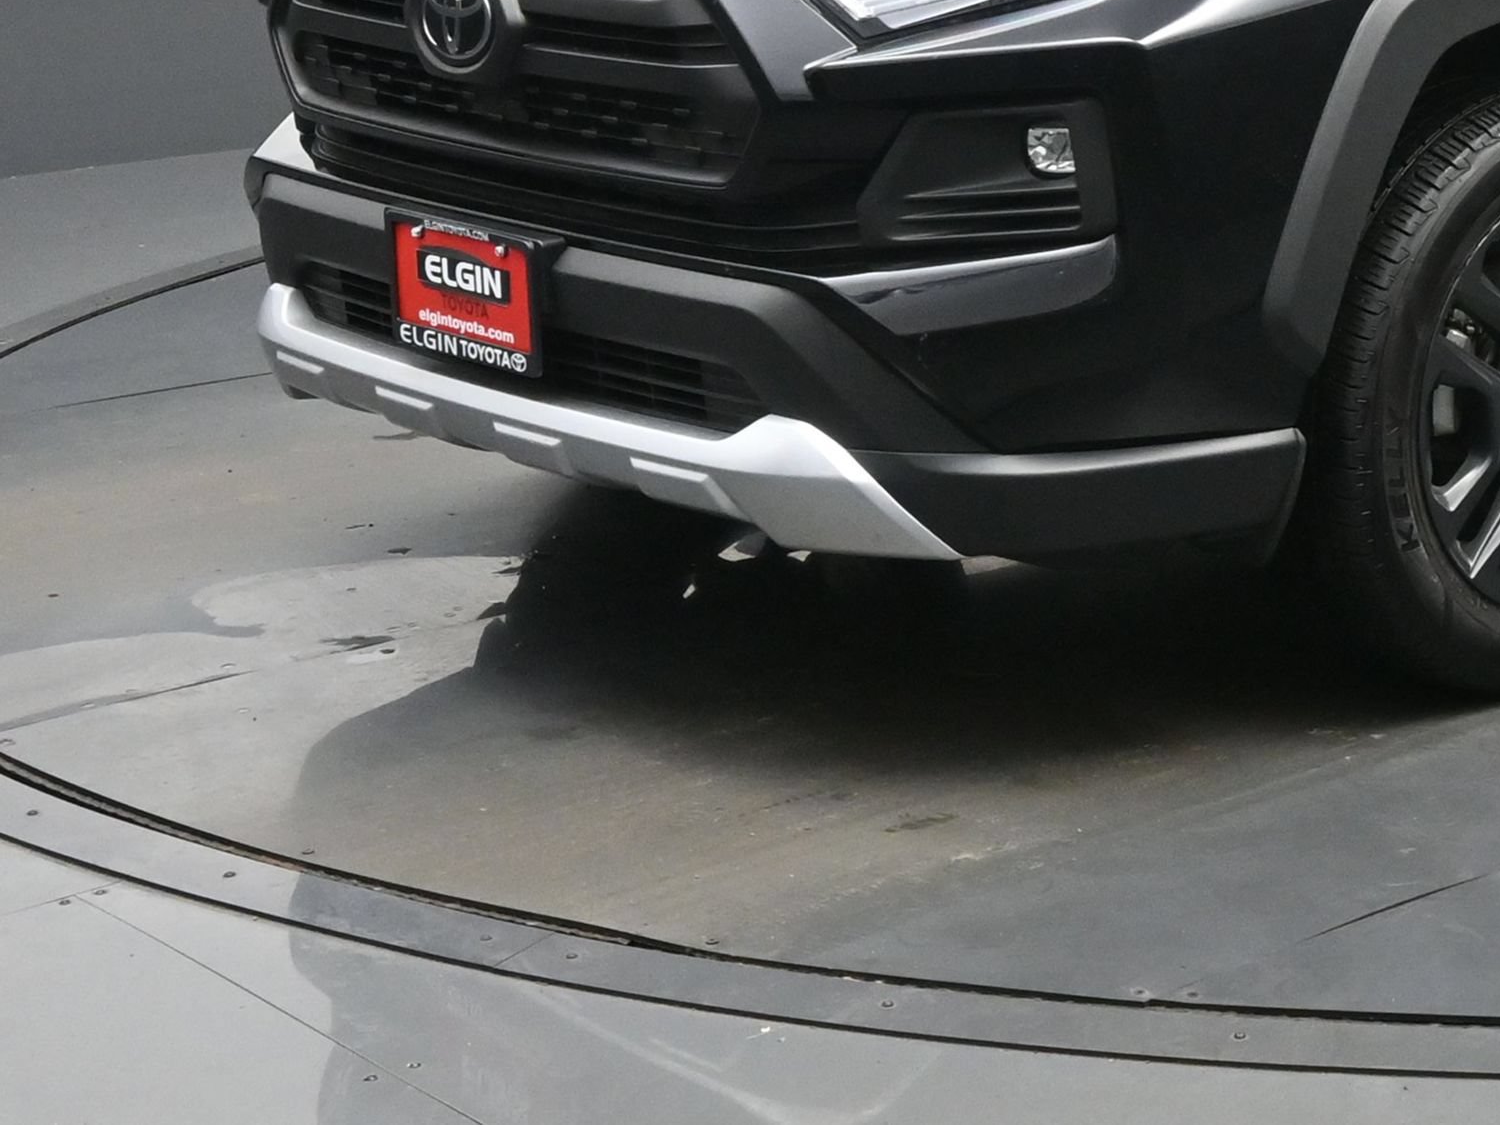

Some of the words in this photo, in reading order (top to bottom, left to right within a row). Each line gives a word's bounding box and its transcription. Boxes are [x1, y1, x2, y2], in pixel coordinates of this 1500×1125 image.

[424, 253, 503, 299] ELGIN
[418, 307, 515, 345] elgintoyota.com
[441, 292, 490, 320] TOYOTA
[399, 323, 458, 357] ELGIN
[459, 338, 512, 371] TOYOTA
[1385, 406, 1421, 552] KELLY
